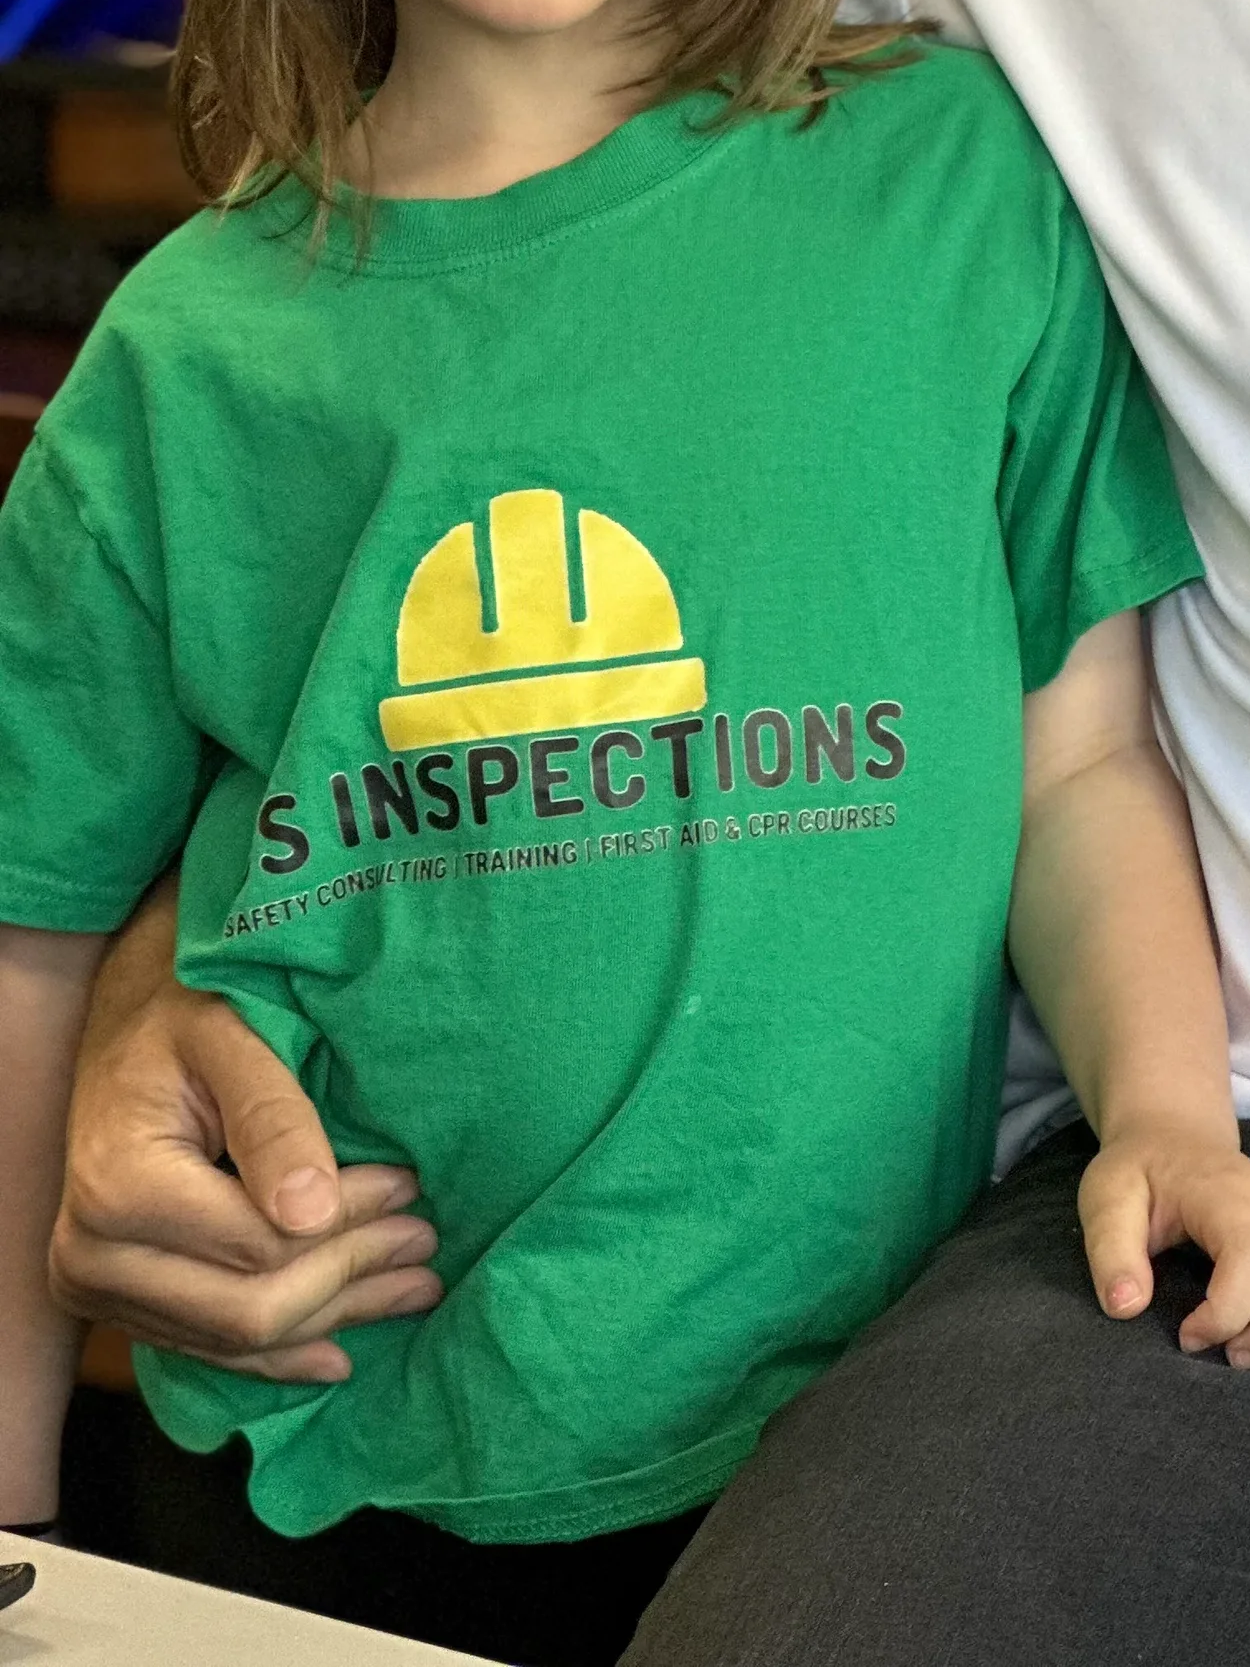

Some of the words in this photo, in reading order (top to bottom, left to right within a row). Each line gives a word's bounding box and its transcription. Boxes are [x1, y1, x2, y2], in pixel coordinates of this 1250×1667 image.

[328, 699, 906, 848] INSPECTIONS
[223, 891, 310, 939] SAFETY
[315, 855, 448, 908] CONSULTING
[463, 839, 578, 877] TRAINING
[599, 825, 671, 860] FIRST
[680, 818, 719, 847] AID
[724, 816, 741, 840] &
[748, 811, 791, 838] CPR
[798, 802, 897, 835] COURSES
